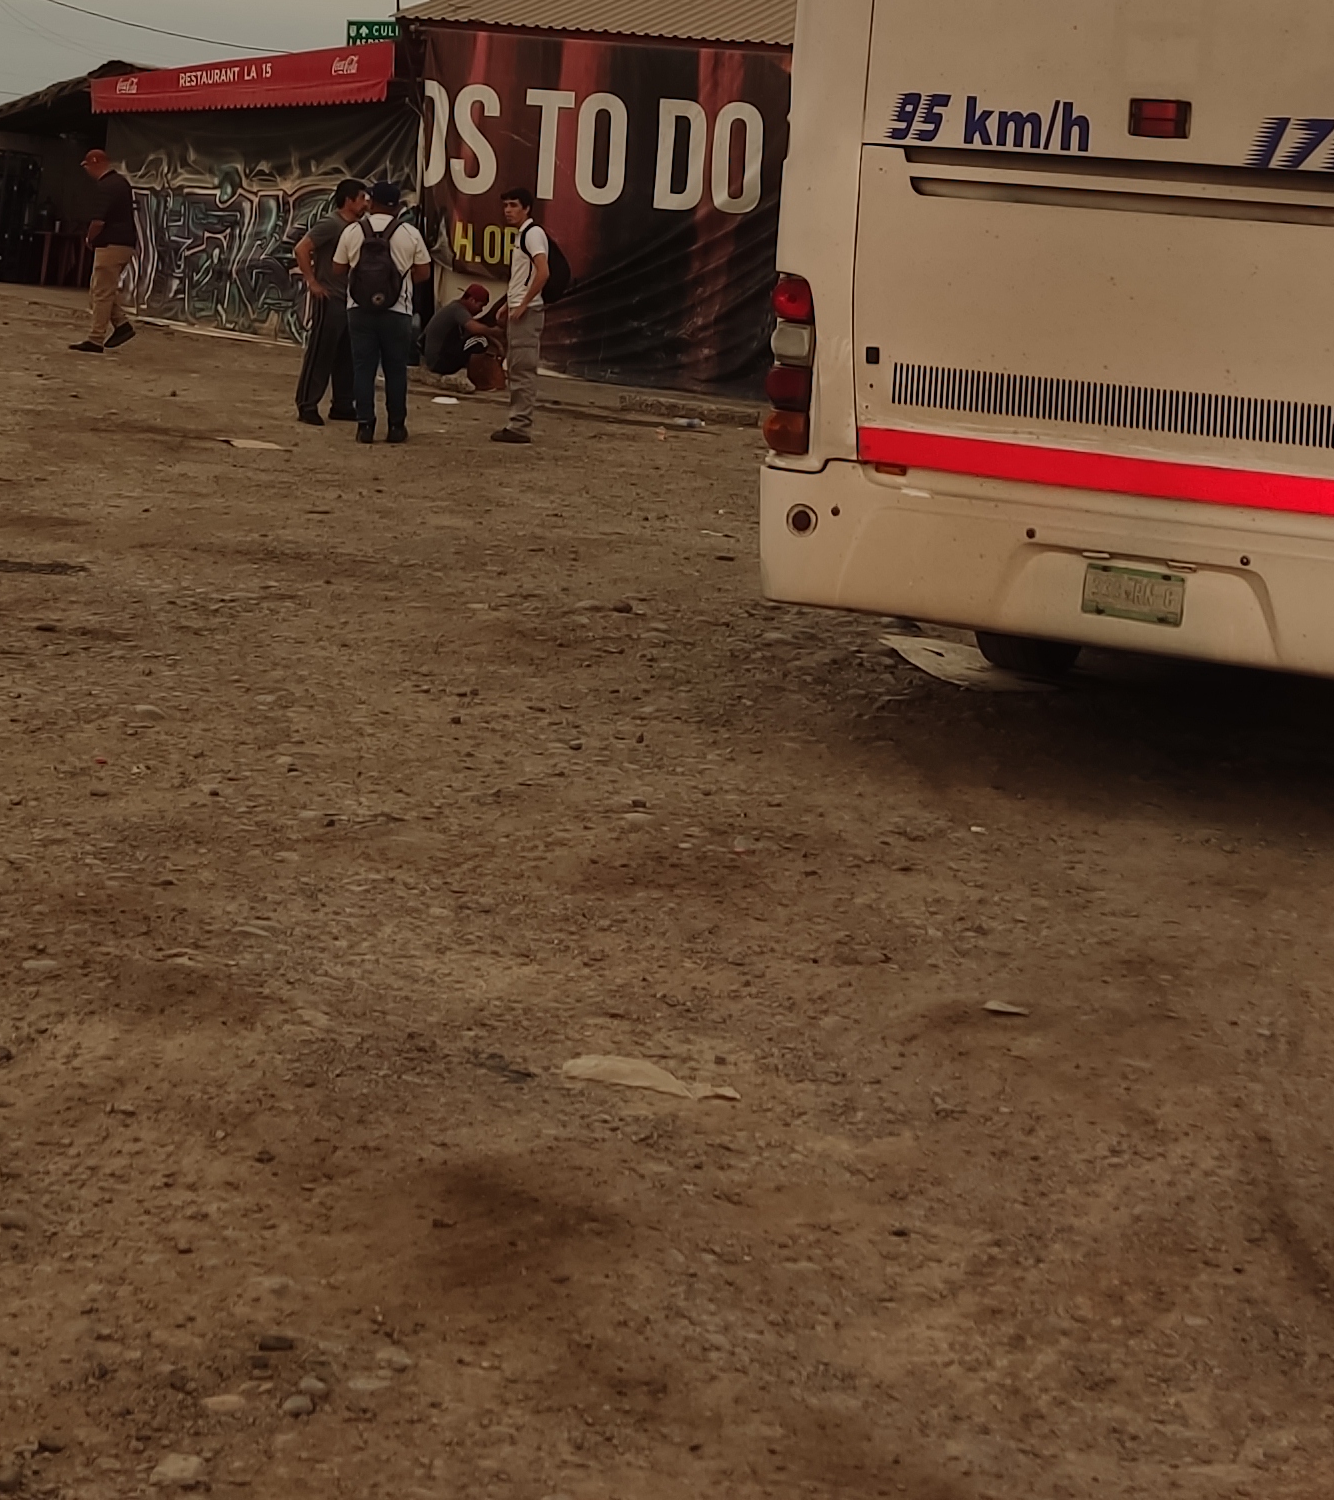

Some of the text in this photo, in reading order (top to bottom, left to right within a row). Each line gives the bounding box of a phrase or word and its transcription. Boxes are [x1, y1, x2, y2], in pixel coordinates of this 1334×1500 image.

[179, 66, 240, 88] RESTAURANT
[244, 65, 257, 81] LA
[262, 63, 272, 79] 15
[526, 88, 628, 205] TO
[653, 98, 764, 214] DO
[884, 92, 1091, 153] 95 km/h
